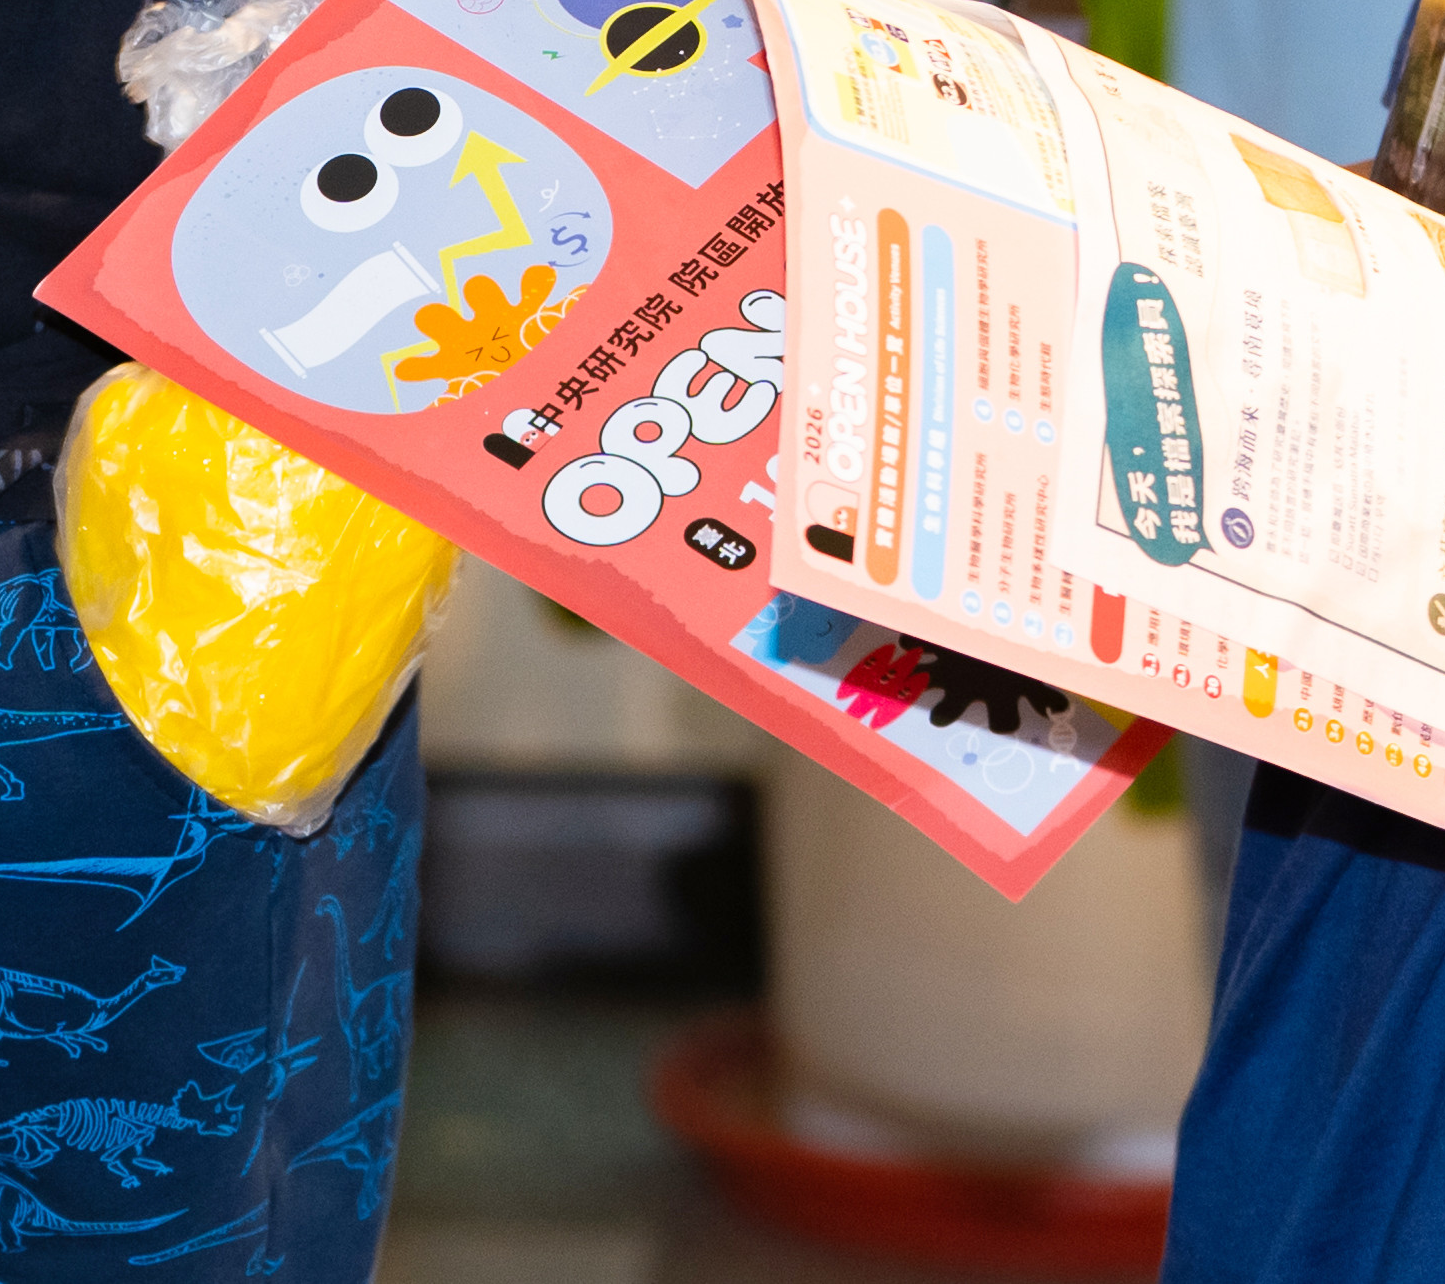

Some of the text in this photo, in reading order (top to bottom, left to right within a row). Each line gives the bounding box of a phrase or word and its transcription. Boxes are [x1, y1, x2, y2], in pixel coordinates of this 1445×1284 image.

[526, 289, 684, 427] 中央研究院
[547, 288, 781, 547] OPEN
[803, 406, 823, 465] 2026
[826, 212, 867, 481] OPEN HOUSE
[1134, 271, 1199, 544] 我是檔案探索員！
